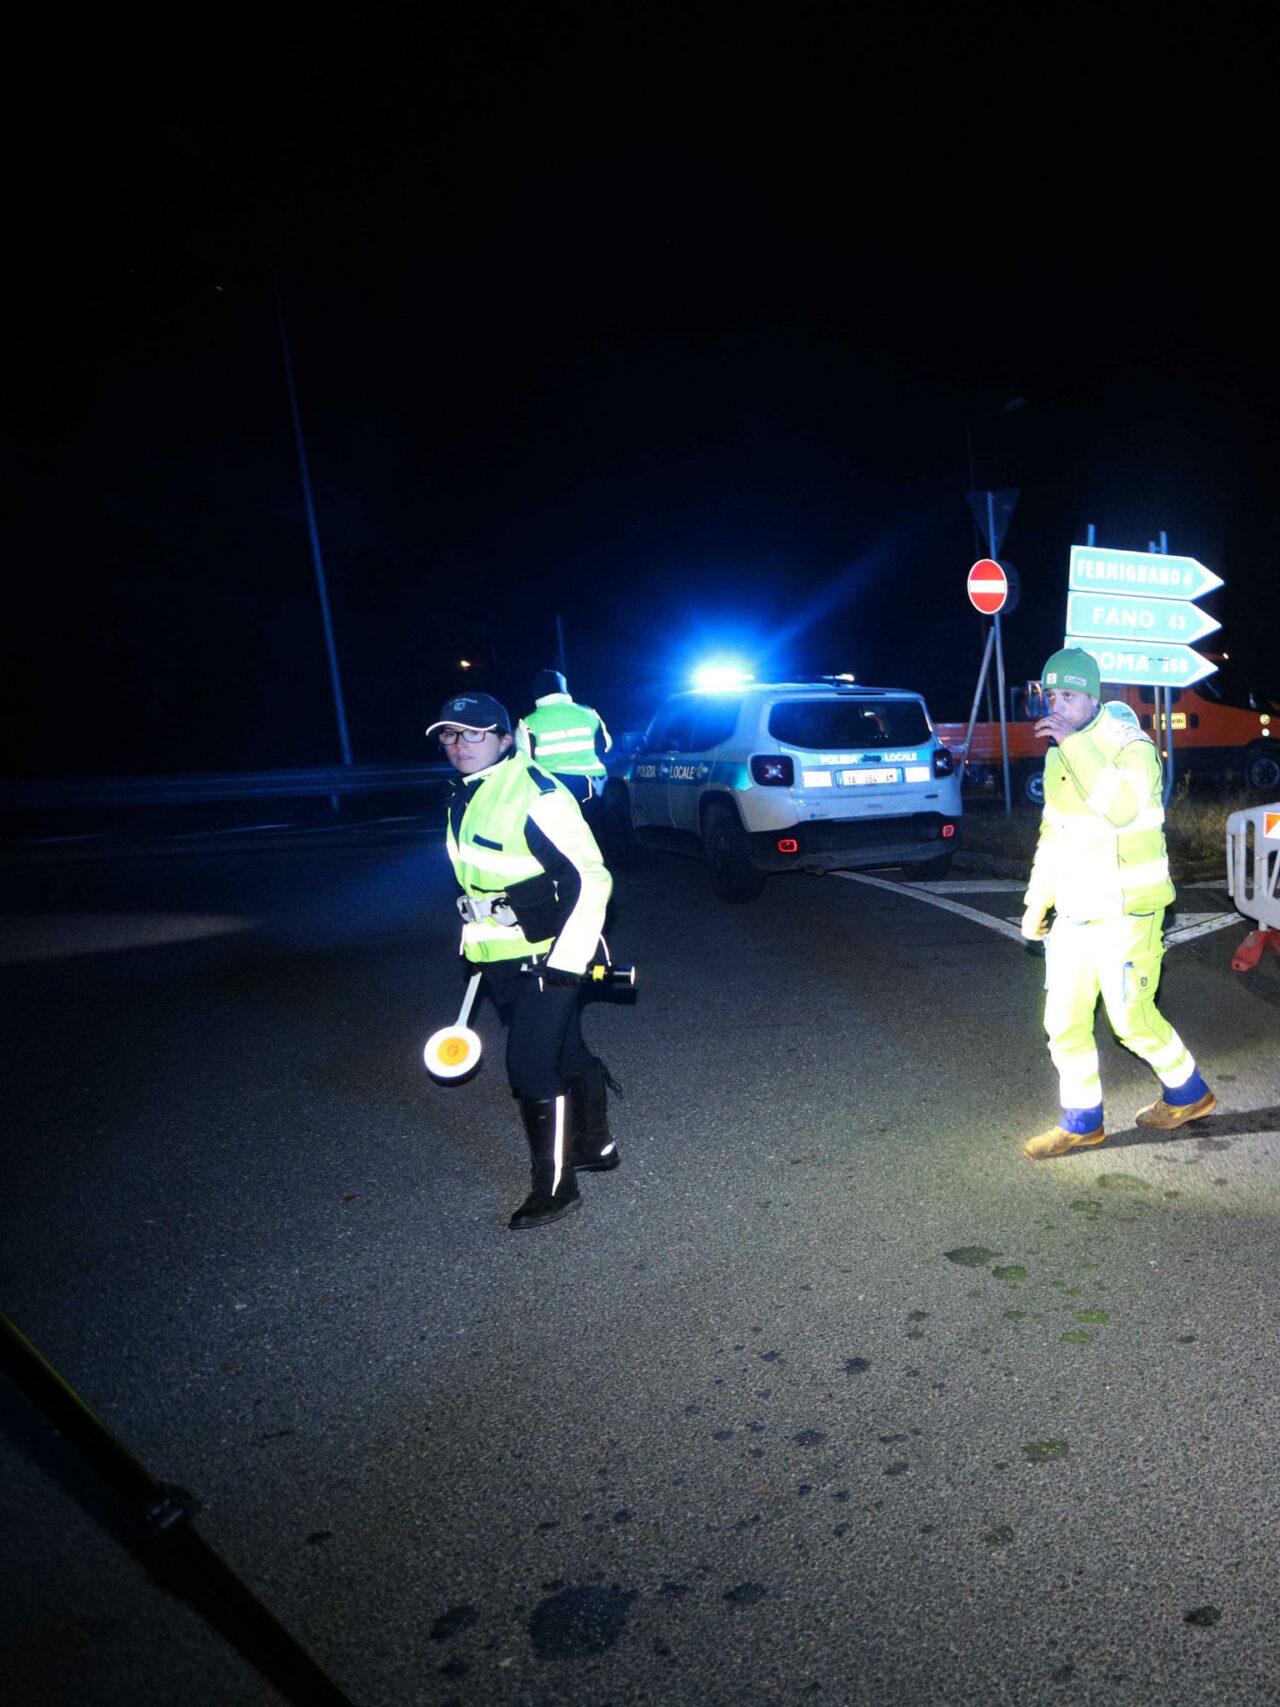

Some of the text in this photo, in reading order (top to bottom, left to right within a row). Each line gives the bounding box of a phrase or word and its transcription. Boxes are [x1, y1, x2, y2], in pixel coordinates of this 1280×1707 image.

[1077, 558, 1181, 586] FERMIGNANO
[1093, 607, 1155, 629] FANO
[1089, 650, 1150, 673] OMA
[820, 752, 917, 765] POLIZIA LOCALE
[636, 765, 694, 779] POLIZIA LOCALE
